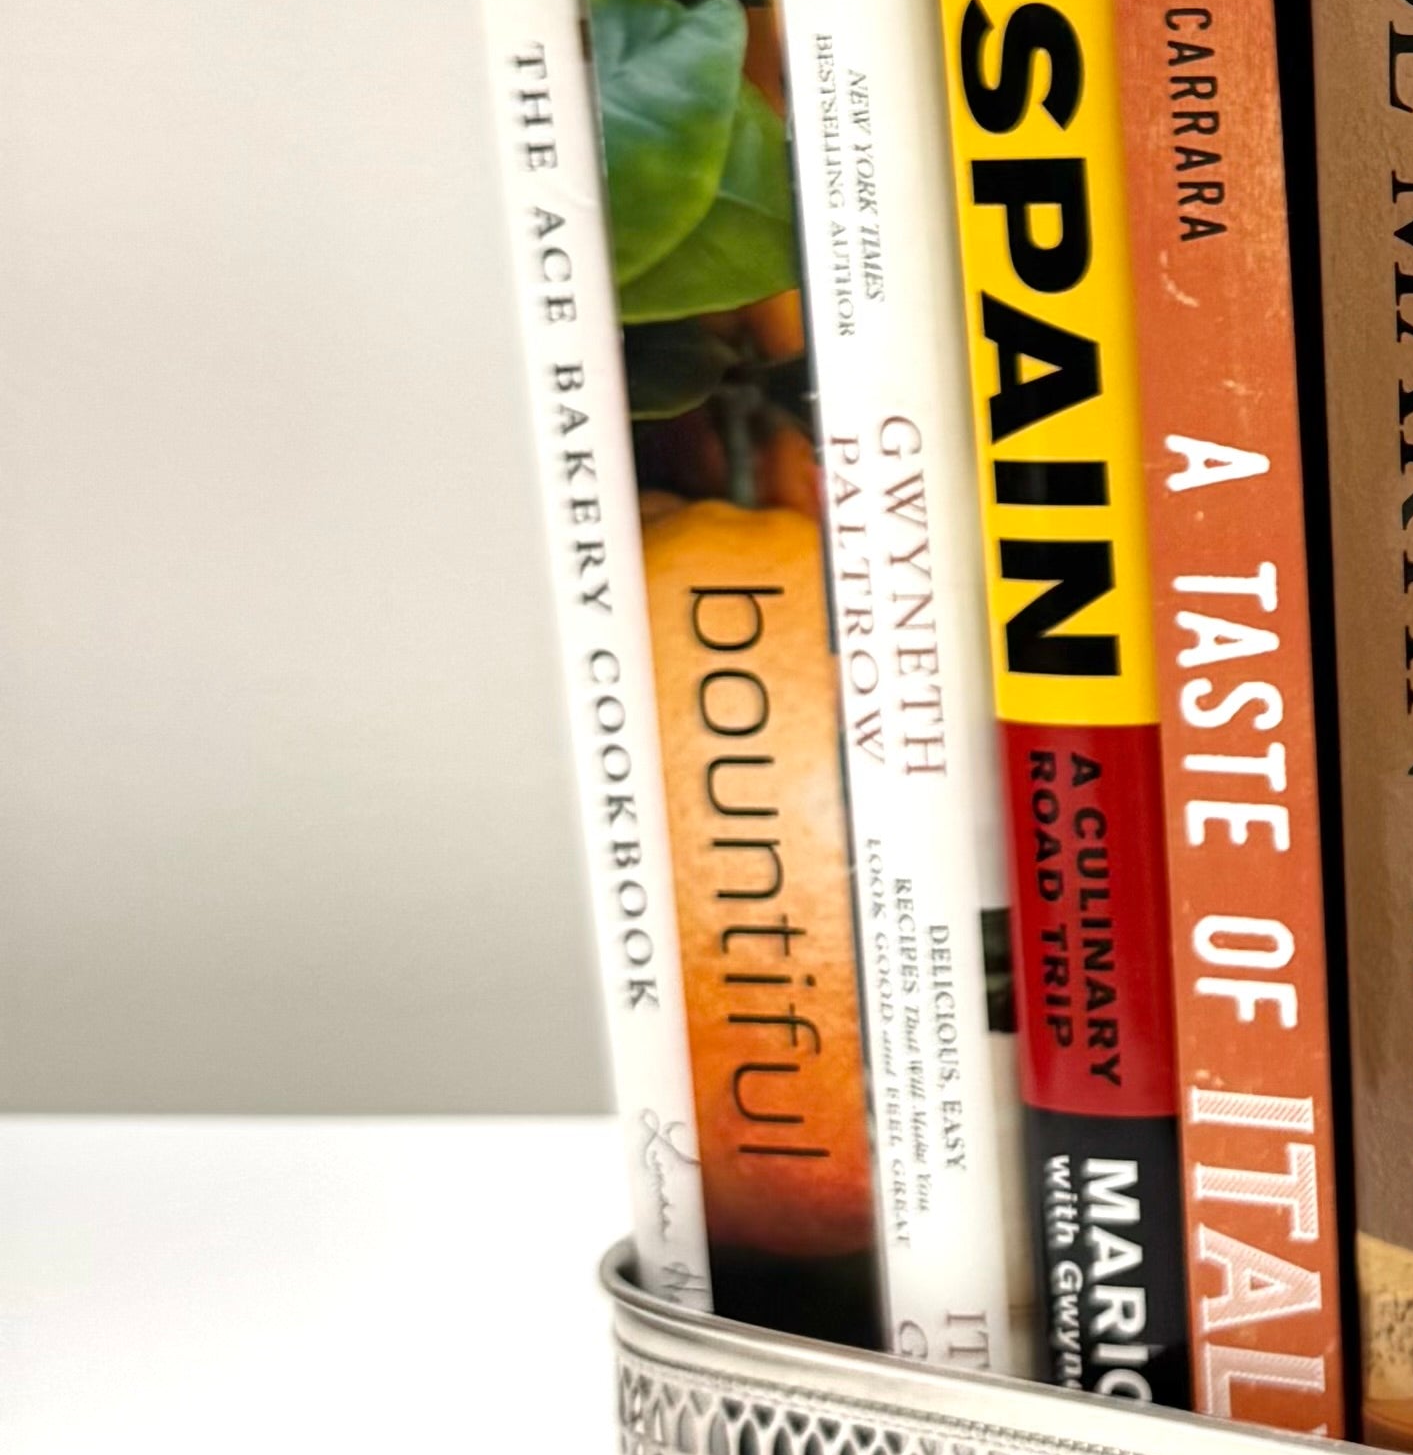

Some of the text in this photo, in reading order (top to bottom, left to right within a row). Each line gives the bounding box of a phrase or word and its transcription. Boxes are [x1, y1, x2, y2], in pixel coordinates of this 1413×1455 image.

[814, 32, 857, 337] BESTSELLING AUTHOR
[847, 68, 886, 303] NEW YORK TIMES
[1164, 7, 1228, 242] CARRARA
[515, 42, 662, 1012] THE ACE BAKERY COOKBOOK
[829, 431, 886, 765] PALTROW
[879, 413, 948, 777] GWYNETH
[688, 583, 831, 1160] bountiful
[892, 877, 921, 993] RECIPES
[1029, 750, 1074, 1048] ROAD TRIP
[1069, 752, 1123, 1090] A CULINARY
[1164, 433, 1330, 1435] A TASTE OF ITAL
[928, 923, 967, 1172] DELICIOUS, EASY
[1043, 1155, 1079, 1246] with
